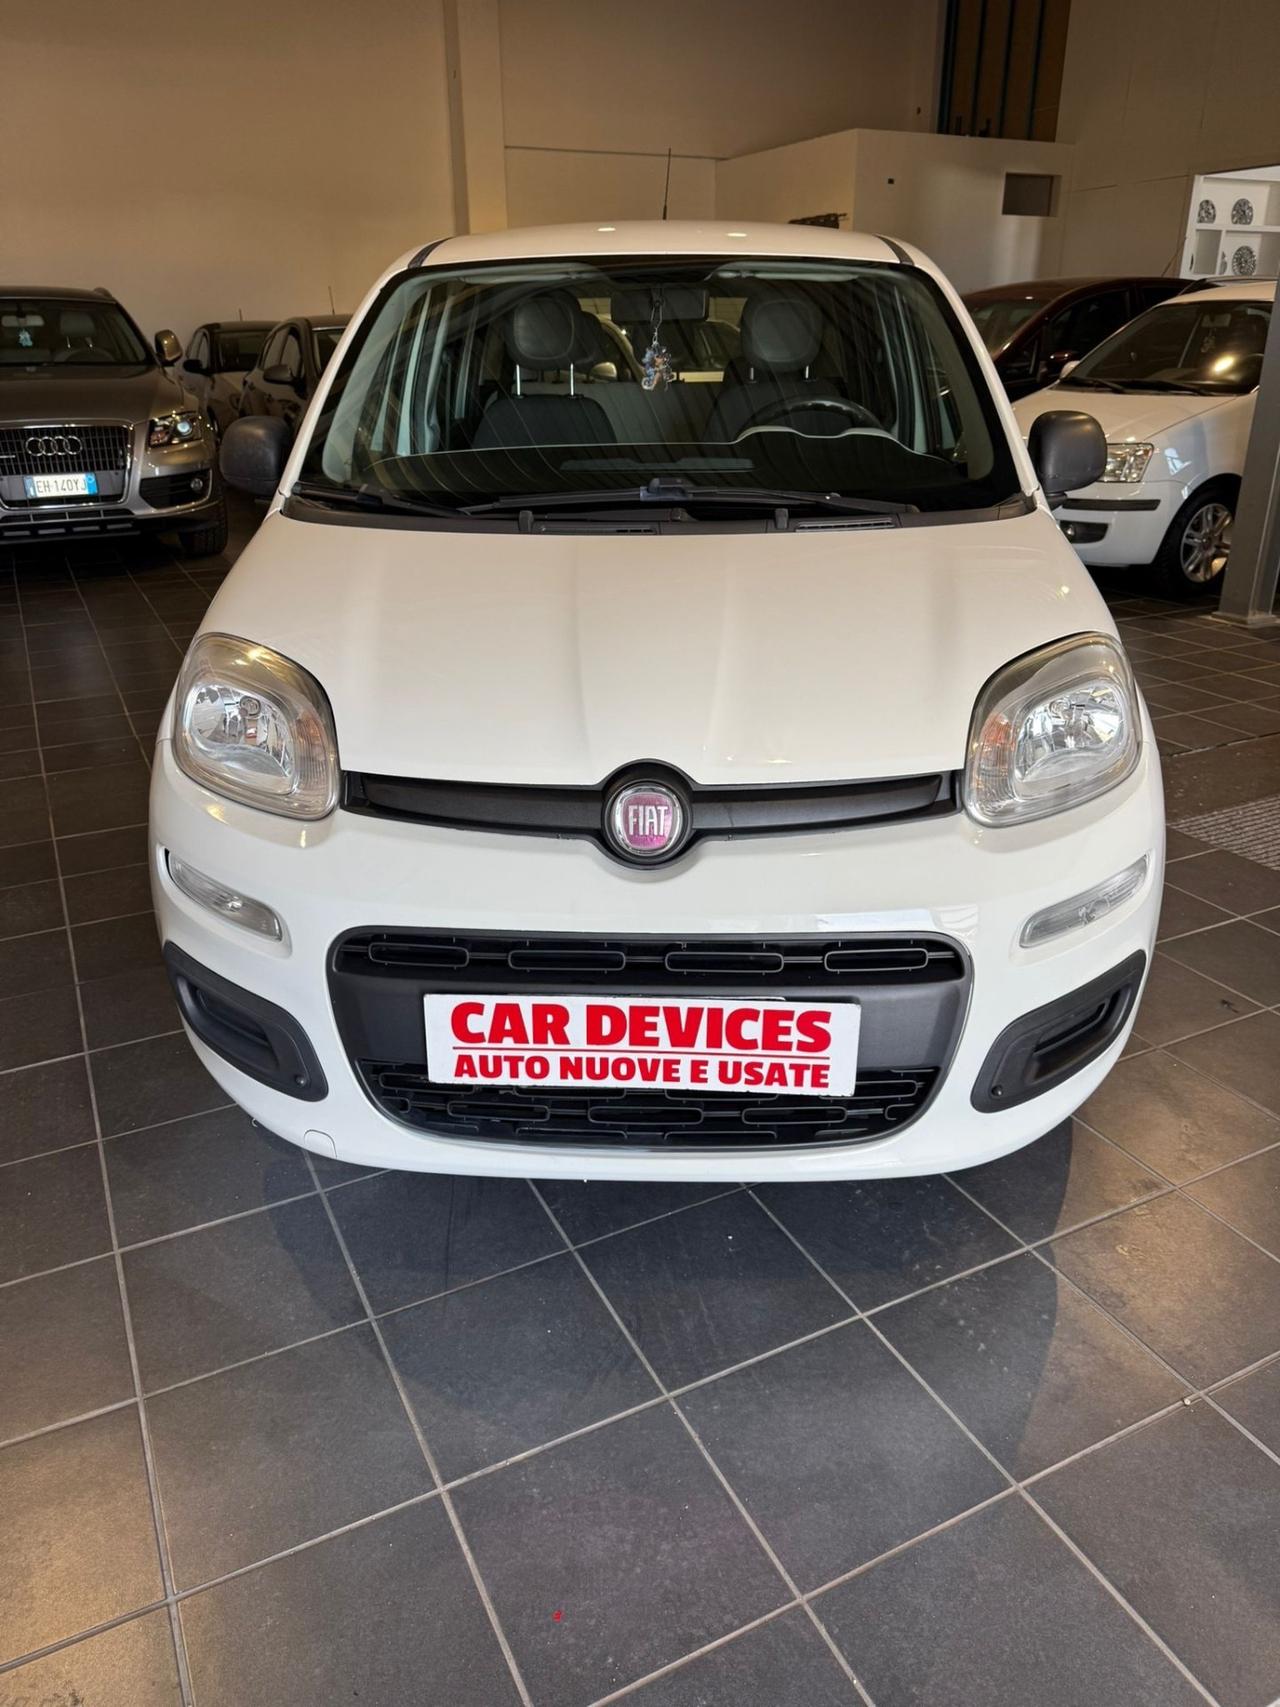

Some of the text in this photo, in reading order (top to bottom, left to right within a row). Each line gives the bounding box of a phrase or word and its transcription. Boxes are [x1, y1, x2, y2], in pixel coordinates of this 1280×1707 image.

[36, 480, 51, 493] EH
[628, 805, 668, 836] FIAT
[450, 1001, 832, 1054] CAR DEVICES
[453, 1053, 830, 1089] AUTO NUOVE E USATE
